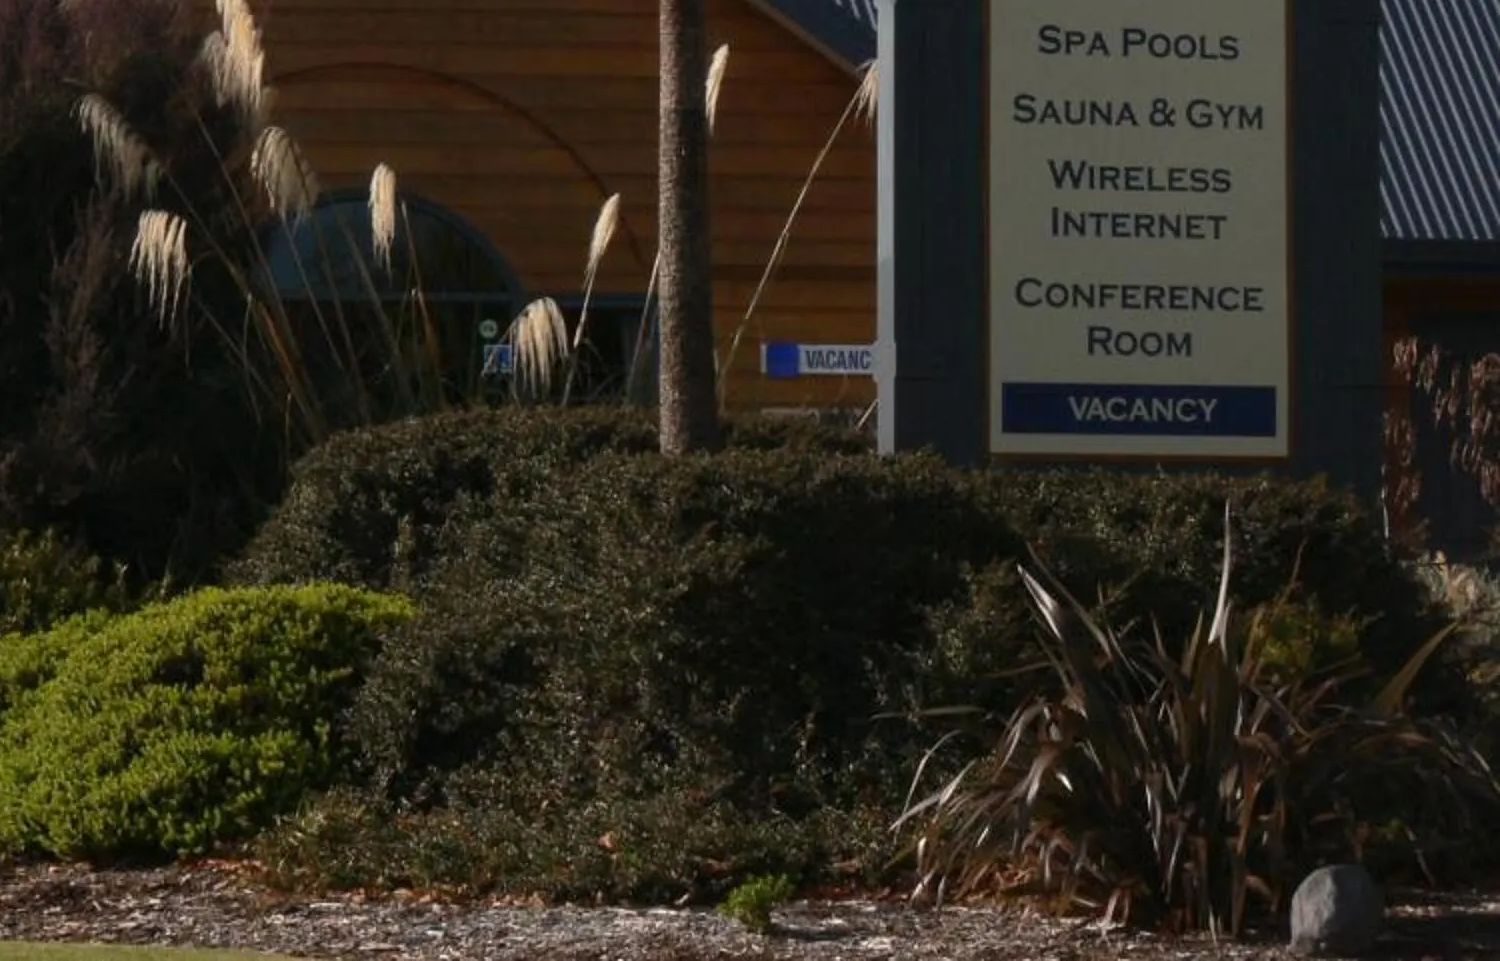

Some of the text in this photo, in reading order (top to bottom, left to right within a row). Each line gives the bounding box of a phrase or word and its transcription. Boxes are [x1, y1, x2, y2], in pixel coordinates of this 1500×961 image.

[1038, 24, 1239, 60] SPA POOLS
[1013, 93, 1264, 130] SAUNA & GYM
[1047, 159, 1232, 193] WIRELESS
[1051, 206, 1227, 240] INTERNET
[1015, 277, 1265, 312] CONFERENCE
[1087, 325, 1193, 357] ROOM
[805, 349, 872, 370] VACANC
[1068, 396, 1218, 422] VACANCY
